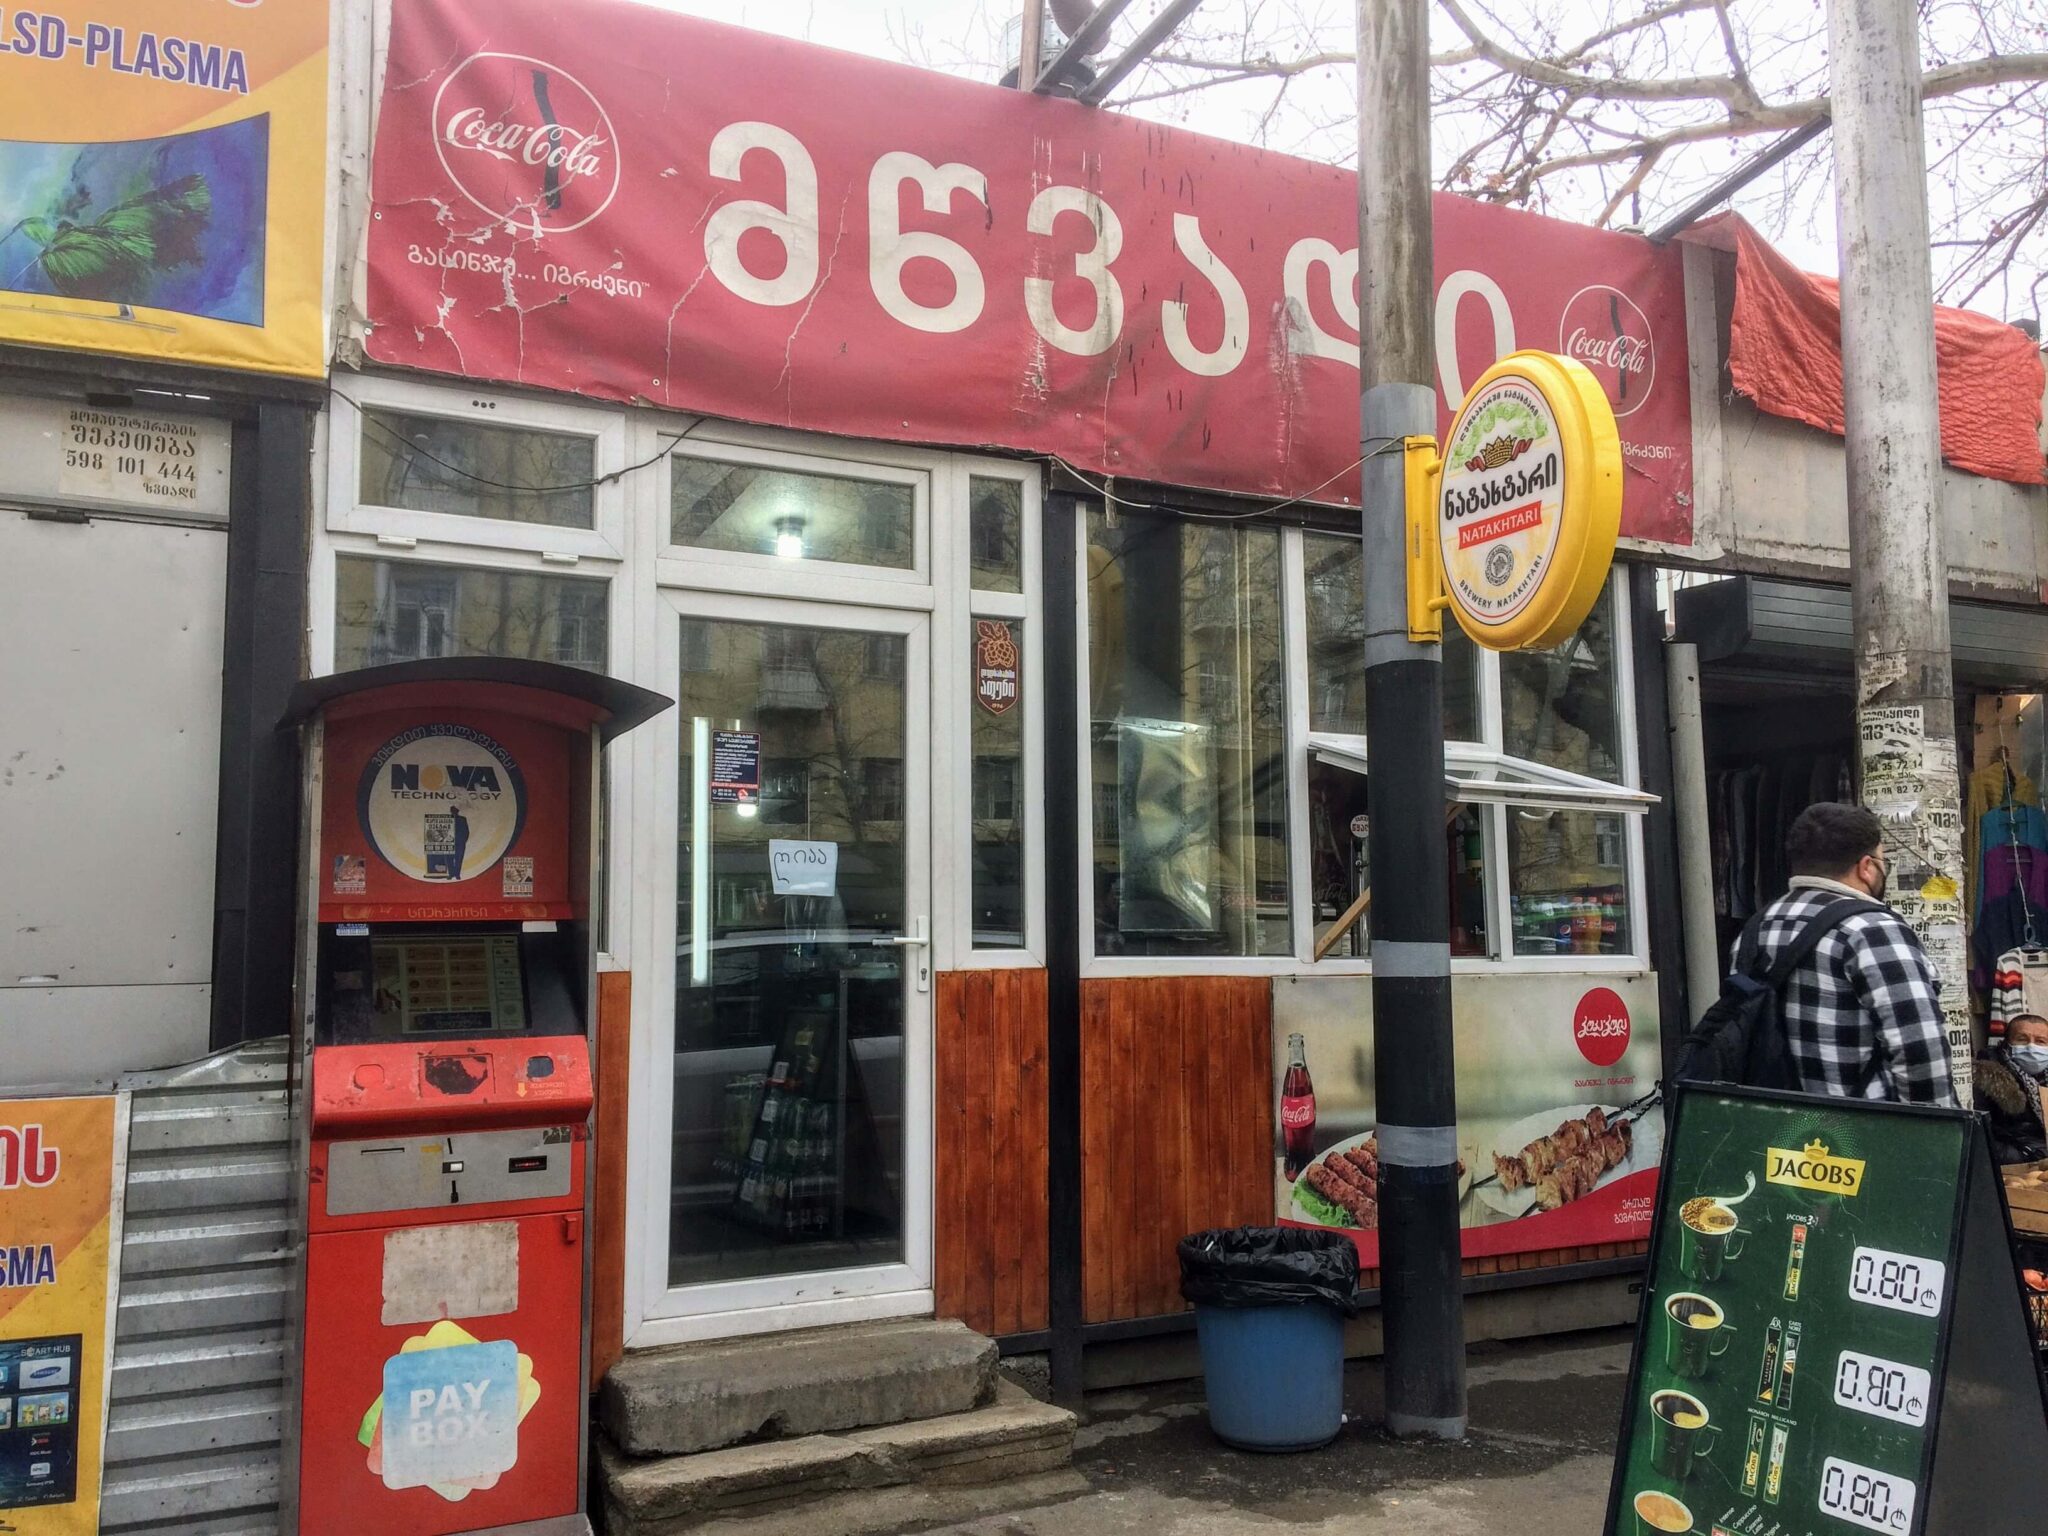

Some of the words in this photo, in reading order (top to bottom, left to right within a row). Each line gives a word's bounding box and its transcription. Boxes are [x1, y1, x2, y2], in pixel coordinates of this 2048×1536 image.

[444, 107, 607, 177] Coca-Cola
[704, 121, 1516, 411] მწვადი
[1567, 327, 1649, 374] Coca-Cola
[71, 424, 196, 458] შეკეთება
[66, 449, 103, 470] 598
[117, 456, 145, 475] 101
[157, 461, 196, 482] 444
[1445, 452, 1557, 521] ნატახტარი
[1462, 508, 1538, 544] NATAKHTARI
[1460, 579, 1492, 609] BREWERY
[1497, 555, 1543, 608] NATAKHTARI
[391, 764, 502, 792] NOVA
[391, 791, 502, 801] TECHNOOGY
[1282, 1104, 1310, 1123] Coca-Cola
[1770, 1157, 1856, 1187] JACOBS
[1622, 1197, 1651, 1210] ერთად
[21, 1346, 51, 1357] SART
[409, 1379, 491, 1419] PAY
[409, 1411, 490, 1448] BOX
